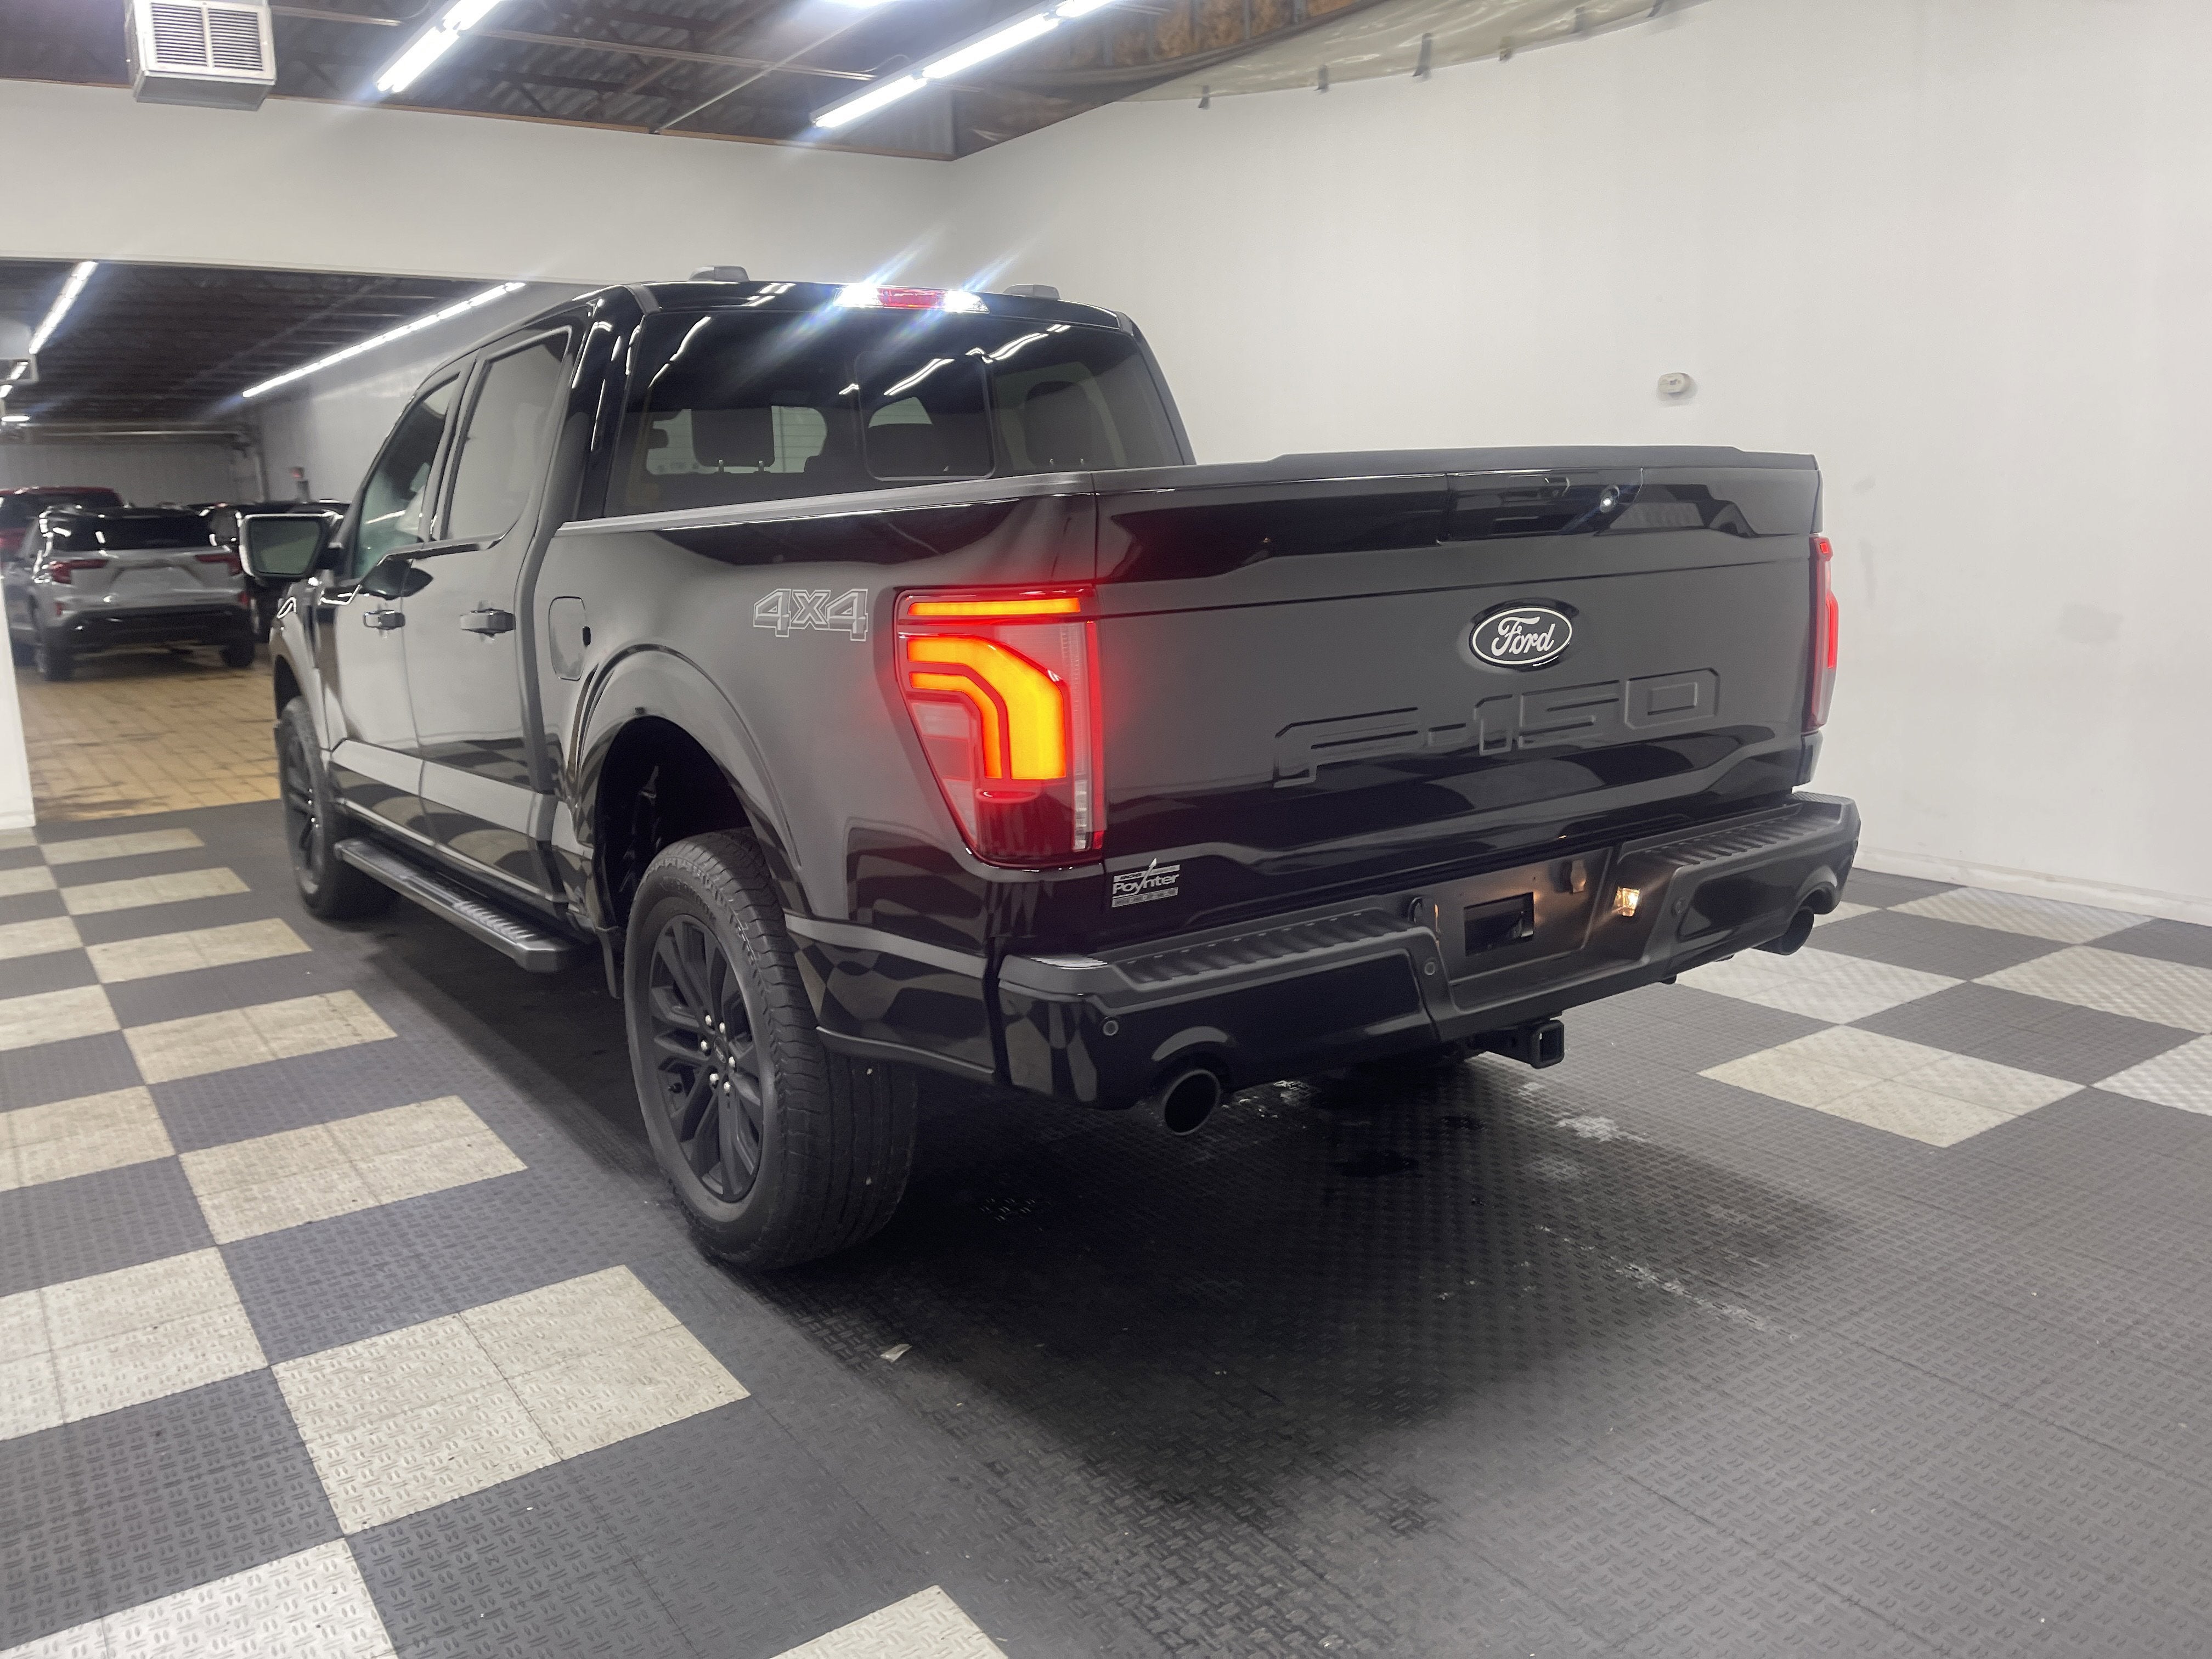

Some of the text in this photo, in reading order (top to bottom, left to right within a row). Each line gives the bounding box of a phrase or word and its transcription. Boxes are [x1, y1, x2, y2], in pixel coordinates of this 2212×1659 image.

[1491, 616, 1556, 657] Ford
[1273, 667, 1720, 788] F-150
[1112, 873, 1180, 897] Poynter
